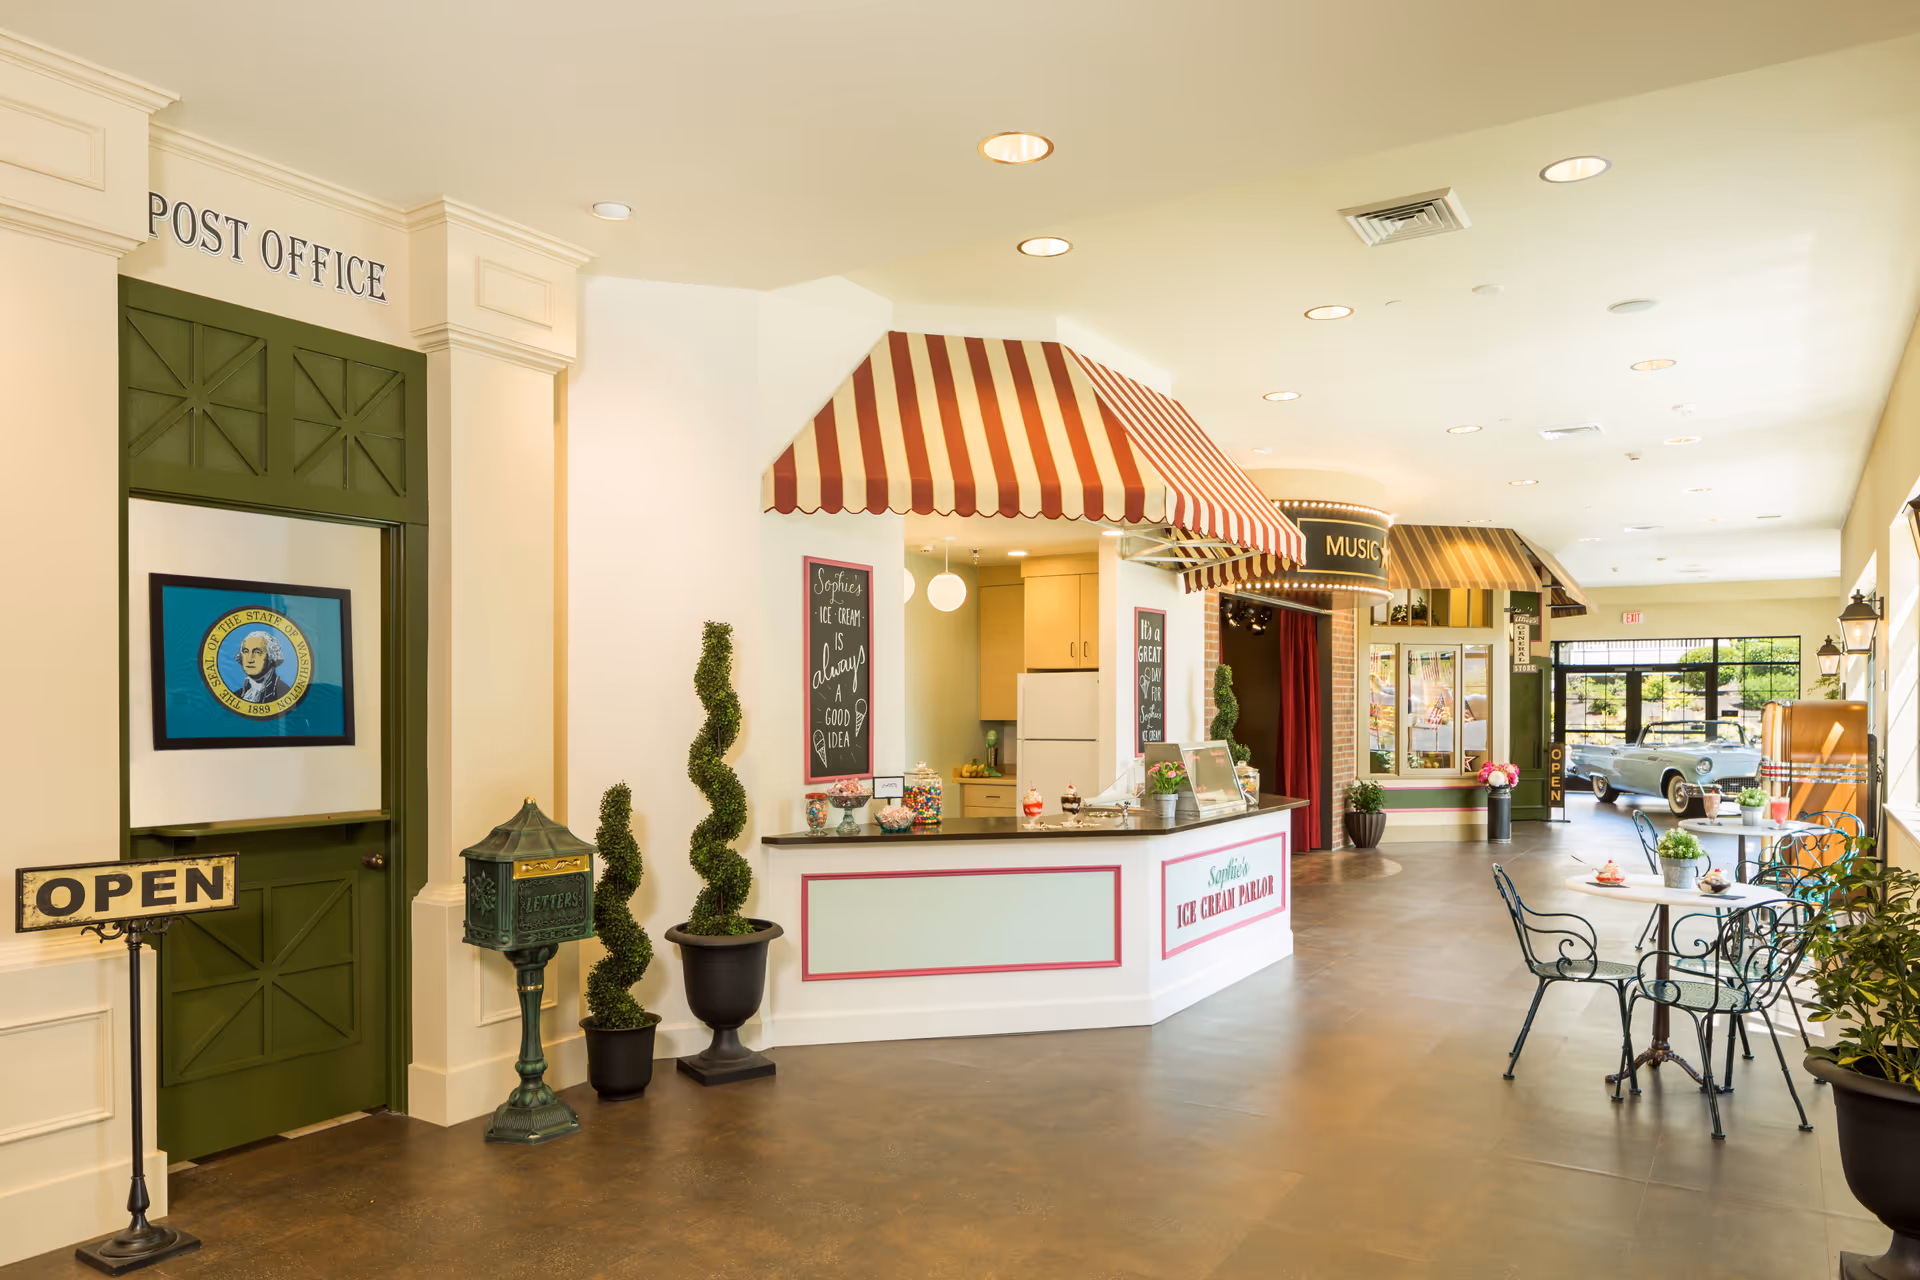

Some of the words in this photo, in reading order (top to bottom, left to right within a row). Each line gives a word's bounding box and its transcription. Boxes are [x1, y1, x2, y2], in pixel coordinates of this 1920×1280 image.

[148, 190, 250, 264] POST
[260, 229, 389, 304] OFFICE
[1326, 535, 1379, 561] MUSIC
[814, 567, 863, 604] Sophie's
[218, 614, 242, 634] THE
[246, 611, 282, 626] STATE
[820, 605, 832, 625] ICE
[838, 607, 861, 627] CREAM
[1626, 612, 1640, 623] EXIT
[284, 624, 299, 638] OF
[1141, 619, 1152, 641] It's
[1154, 628, 1161, 642] a
[208, 634, 220, 651] OF
[835, 632, 844, 651] IS
[1517, 625, 1526, 662] GENERAL
[1138, 645, 1162, 663] GREAT
[205, 656, 222, 688] SEAL
[276, 640, 310, 711] WASHINGTON
[813, 642, 866, 693] always
[1151, 667, 1162, 682] DAY
[219, 689, 241, 710] THE
[835, 684, 842, 702] A
[1151, 686, 1162, 701] FOR
[248, 704, 271, 714] 1889
[825, 707, 851, 727] GOOD
[828, 731, 850, 749] IDEA
[1149, 729, 1162, 742] CREAM
[1551, 749, 1562, 801] OPEN
[1208, 856, 1250, 890] Sophie's
[36, 865, 224, 917] OPEN
[526, 891, 579, 913] LETTERS
[1177, 900, 1197, 929] ICE
[1200, 887, 1235, 920] CREAM
[1238, 875, 1274, 907] PARLOR
